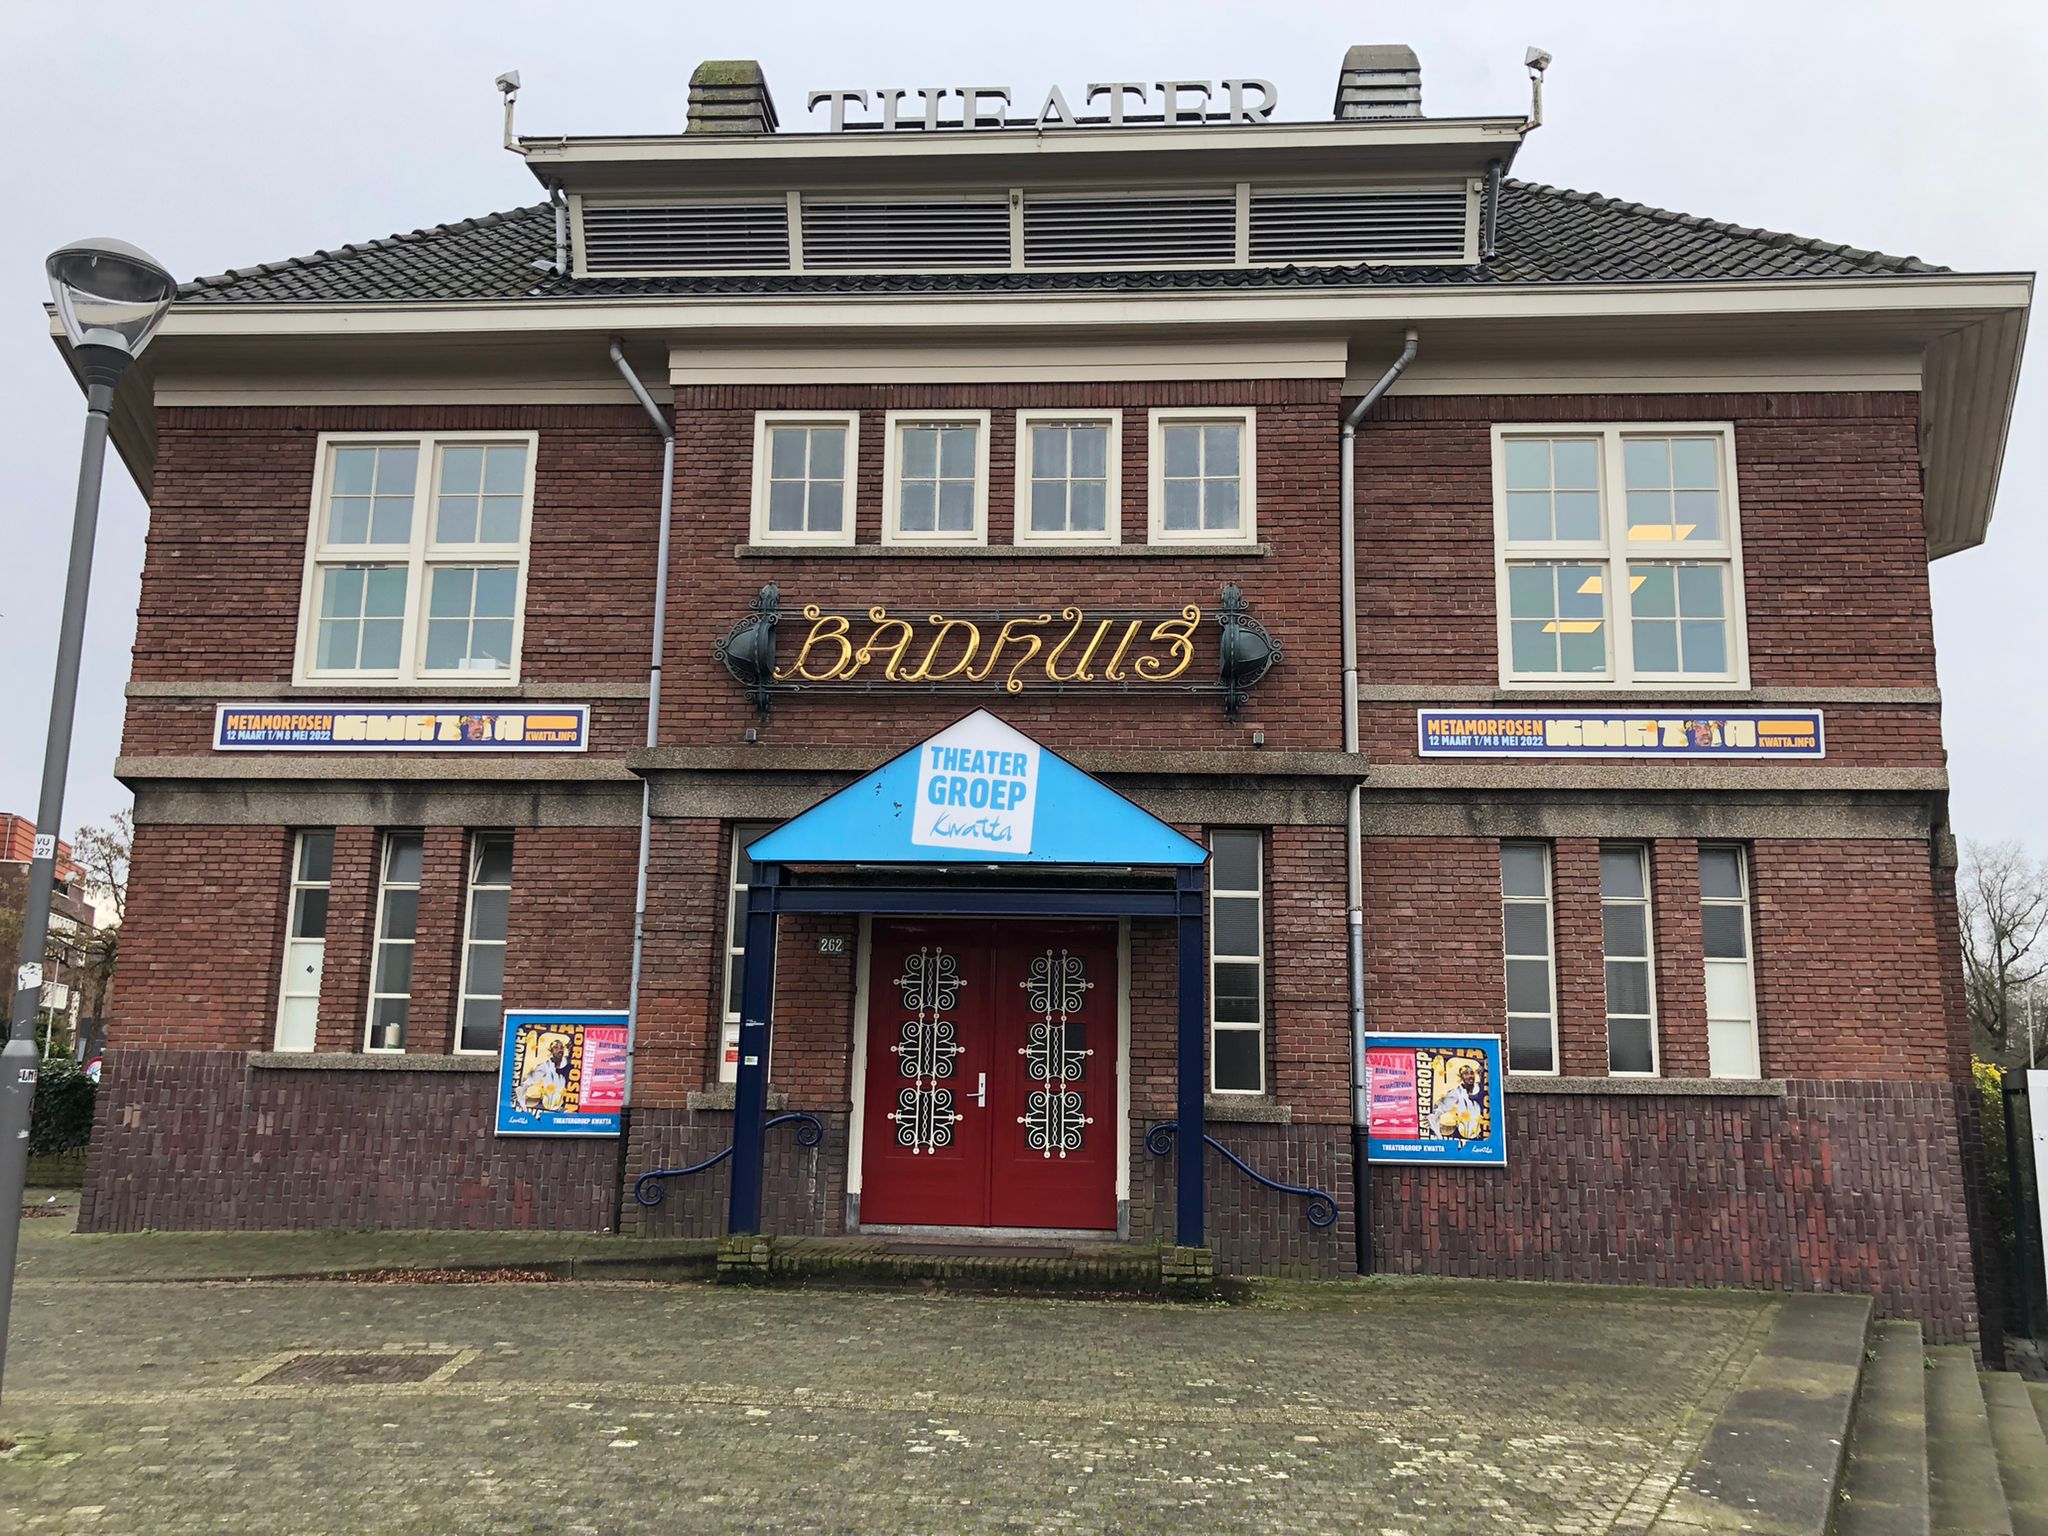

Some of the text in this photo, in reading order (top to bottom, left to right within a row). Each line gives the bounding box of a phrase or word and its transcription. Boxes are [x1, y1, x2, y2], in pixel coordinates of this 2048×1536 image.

[808, 79, 1278, 132] THEATER
[774, 603, 1202, 695] BADHUIS
[227, 715, 332, 729] METAMORFOSEN
[1428, 720, 1543, 736] METAMORFOSEN
[227, 730, 330, 740] 12 MAART T/M 8 MEI 2022
[525, 731, 576, 741] KWATTA.INFO
[1429, 736, 1543, 746] 12 MAART T/M 8 MEI 2022
[1759, 737, 1815, 747] KWATTA.INFO
[931, 746, 1028, 777] THEATER
[928, 775, 1027, 811] GROEP
[930, 810, 1012, 842] Kwatta
[36, 838, 50, 846] VU
[821, 938, 842, 952] 262
